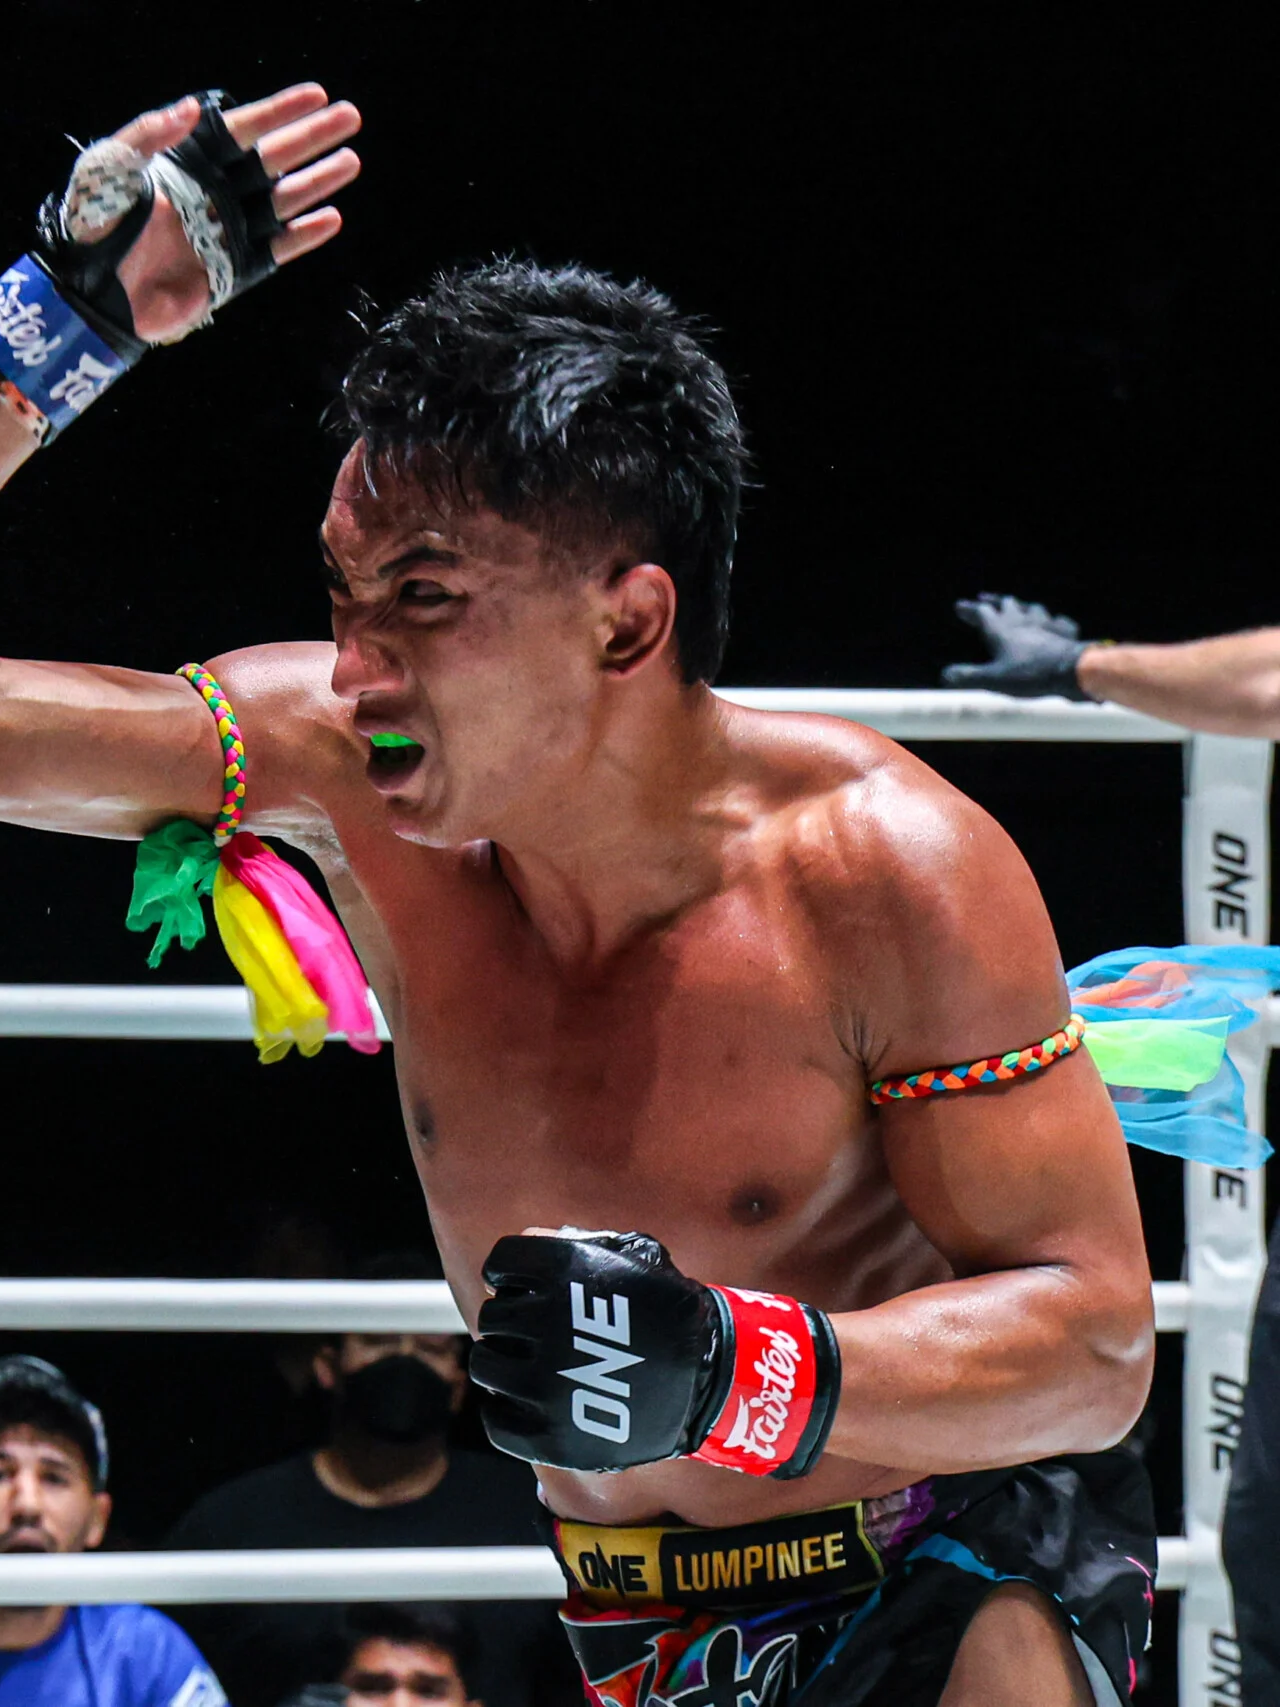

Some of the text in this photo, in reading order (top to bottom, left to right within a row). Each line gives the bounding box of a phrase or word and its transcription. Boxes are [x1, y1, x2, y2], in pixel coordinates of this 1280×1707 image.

[1211, 830, 1253, 938] ONE
[557, 1281, 646, 1444] ONE
[723, 1326, 803, 1460] Fairtex
[578, 1532, 847, 1597] ONE LUMPINEE
